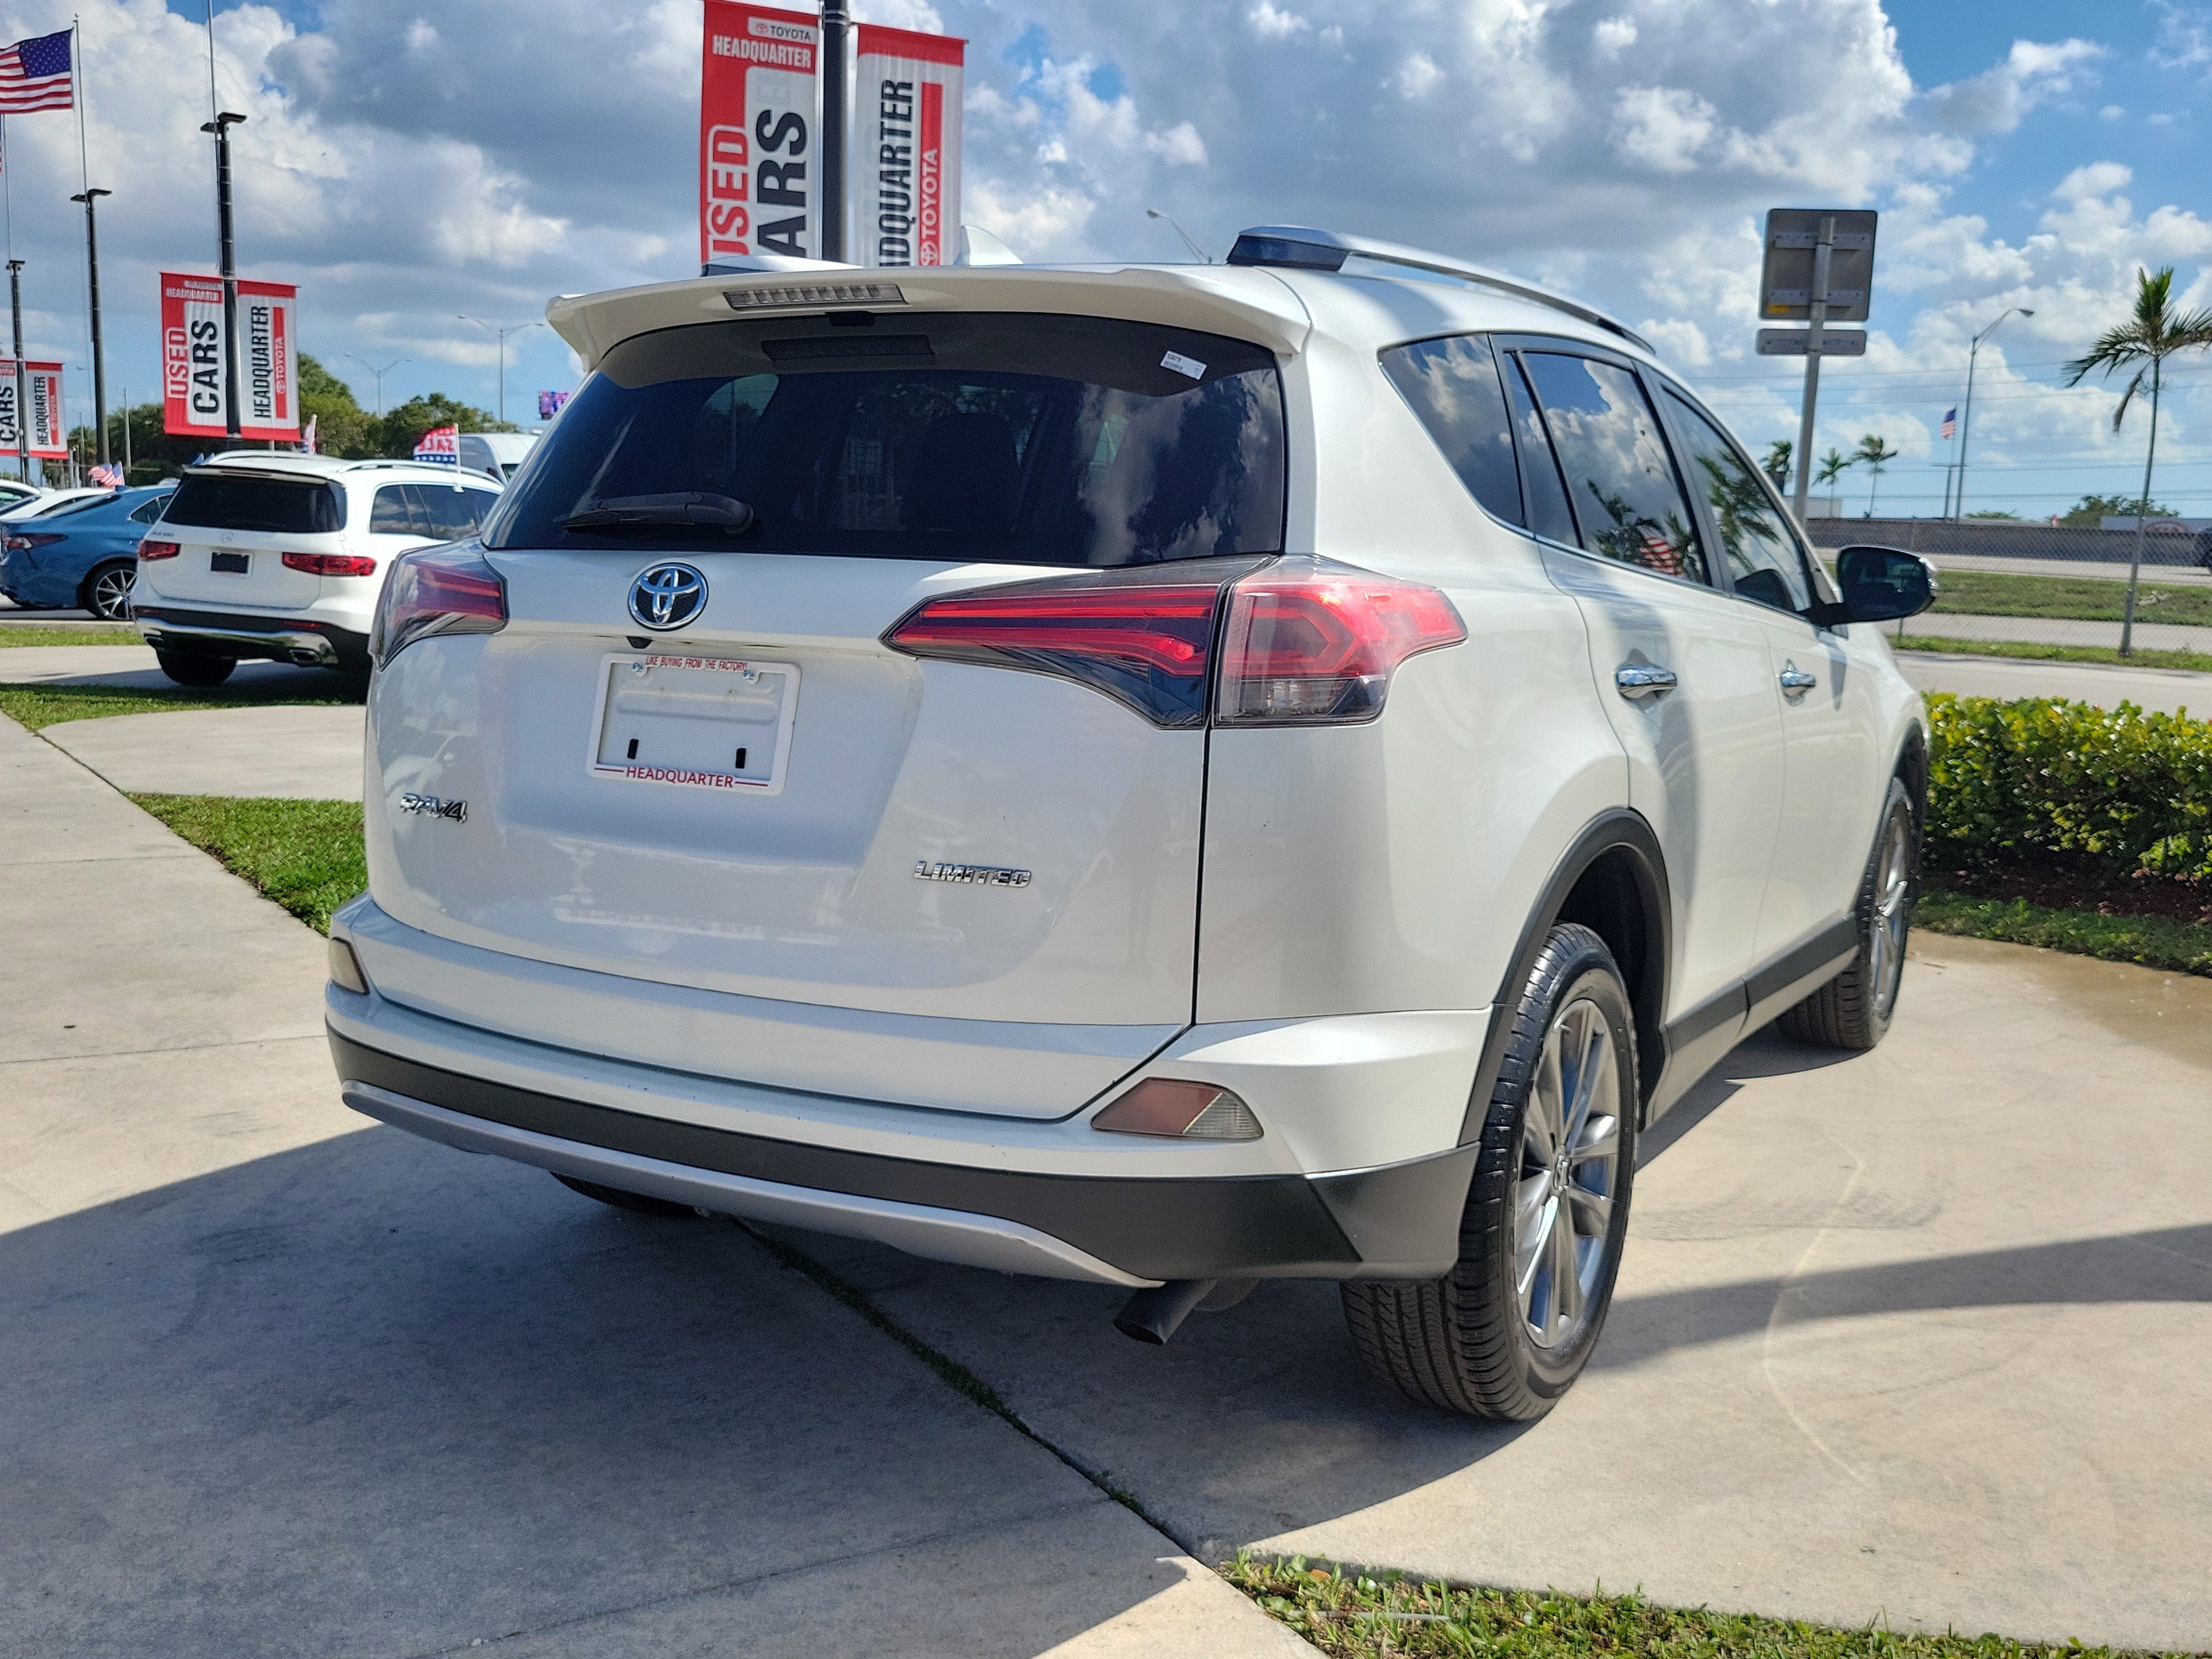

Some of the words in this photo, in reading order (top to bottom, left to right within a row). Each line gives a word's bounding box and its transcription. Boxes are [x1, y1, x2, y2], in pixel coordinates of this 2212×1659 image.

[713, 34, 812, 69] HEADQUARTER
[770, 25, 812, 42] TOYOTA
[756, 110, 807, 258] ARS
[879, 79, 916, 267] DQUARTER
[921, 148, 938, 240] TOYOTA
[166, 287, 219, 301] HEADQUARTER
[168, 330, 189, 396] USED
[191, 320, 220, 414] CARS
[251, 306, 273, 418] HEADQUARTER
[0, 386, 16, 442] CARS
[34, 376, 50, 445] HEADQUARTER
[646, 656, 658, 665] LIKE
[661, 657, 682, 667] BUYING
[686, 658, 703, 668] FROM
[706, 659, 716, 669] THE
[719, 660, 748, 671] FACTORY!
[625, 766, 734, 788] HEADQUARTER
[400, 793, 467, 823] RAV4
[913, 861, 1032, 888] LIMITED
